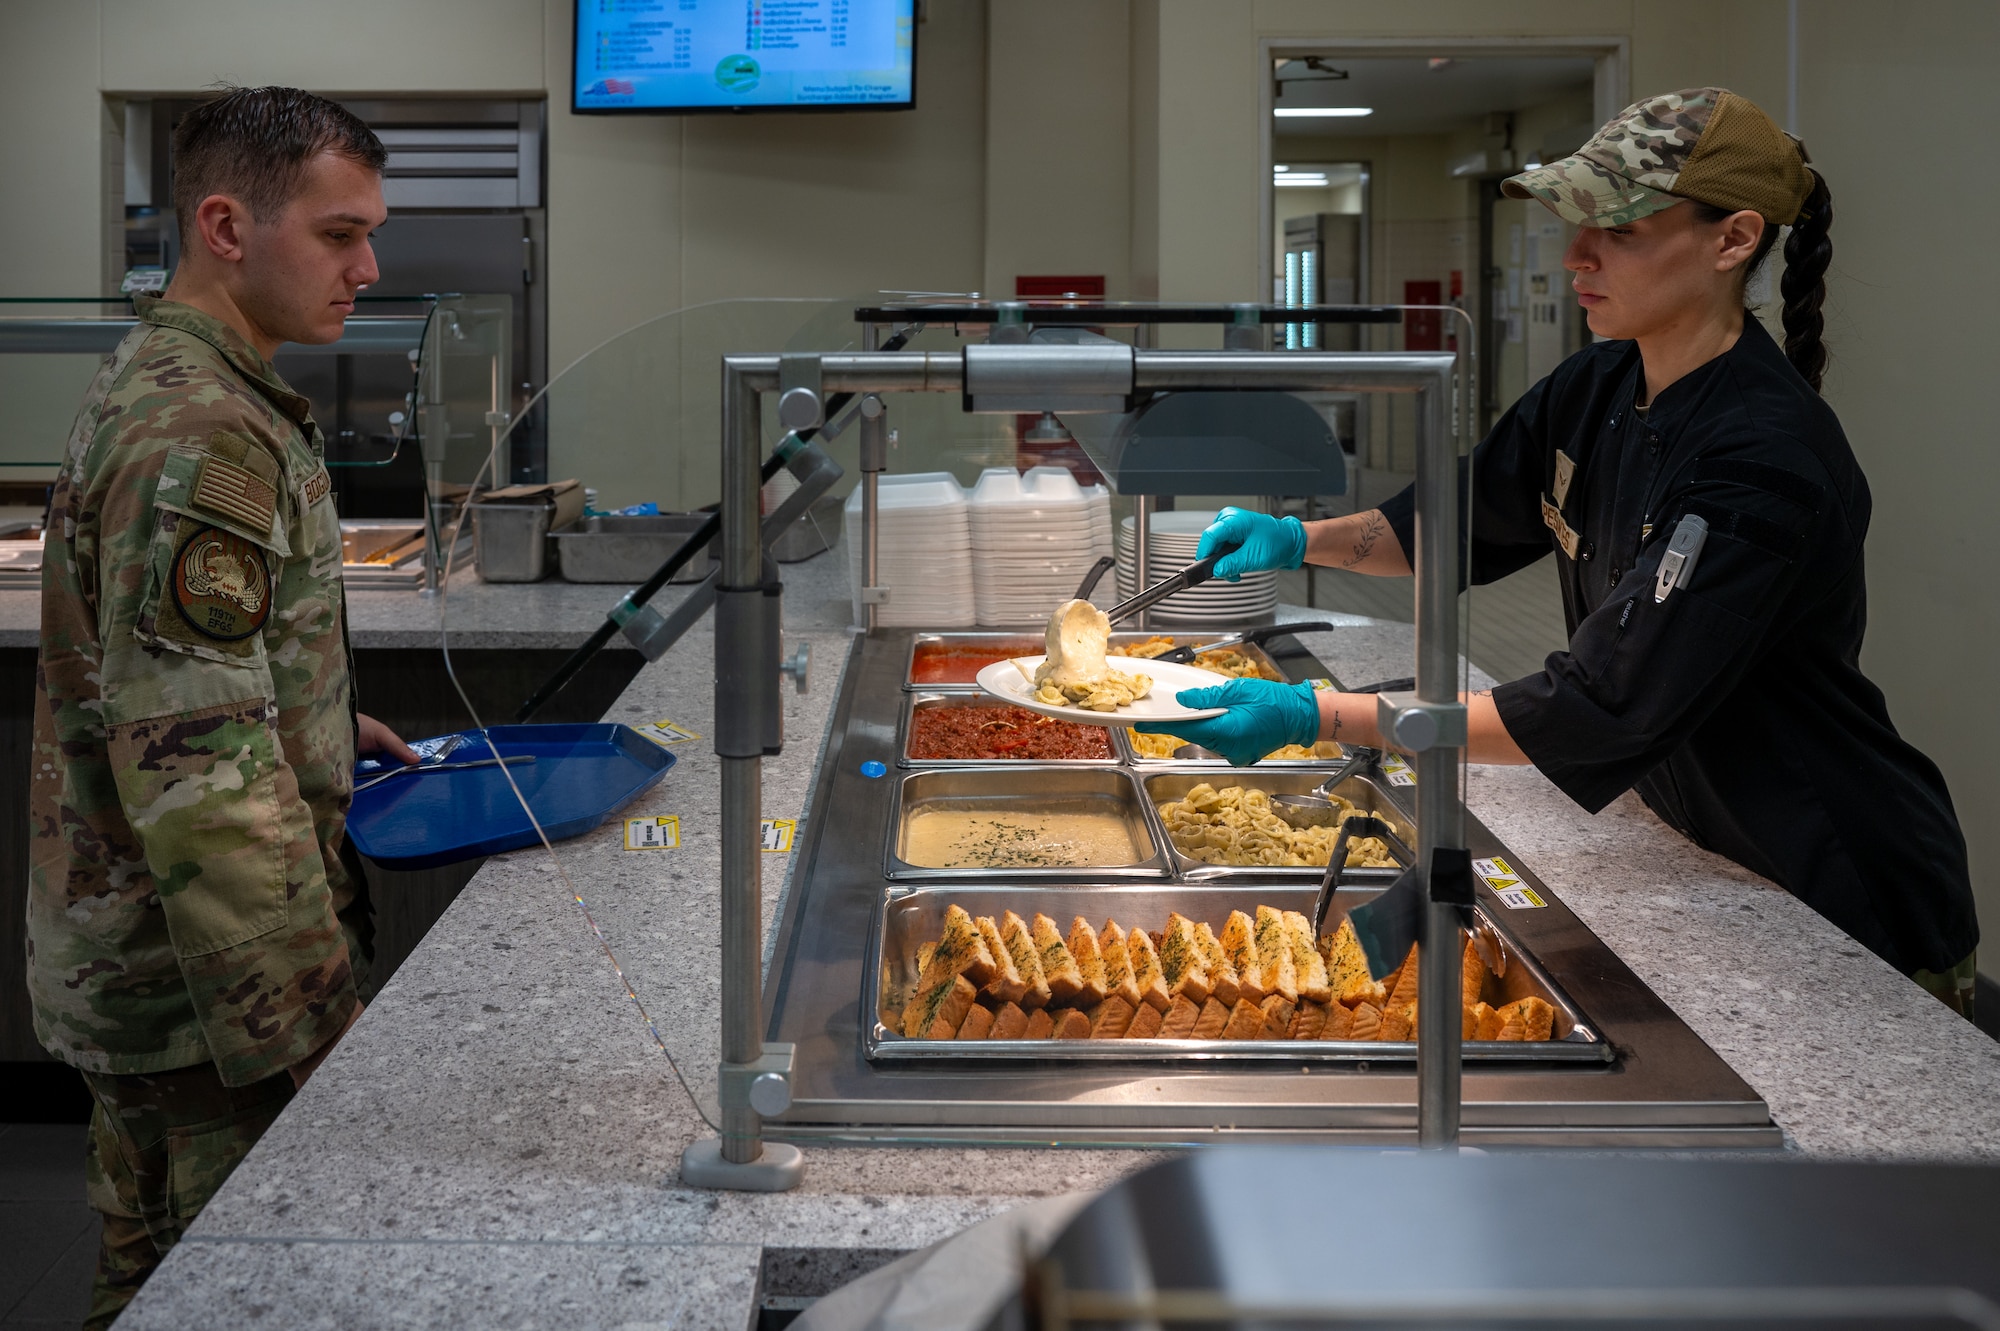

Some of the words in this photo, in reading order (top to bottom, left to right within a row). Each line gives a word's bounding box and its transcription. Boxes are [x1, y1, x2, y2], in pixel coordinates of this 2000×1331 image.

[864, 84, 892, 93] Change
[208, 606, 236, 623] 119TH
[207, 619, 233, 633] EFGS
